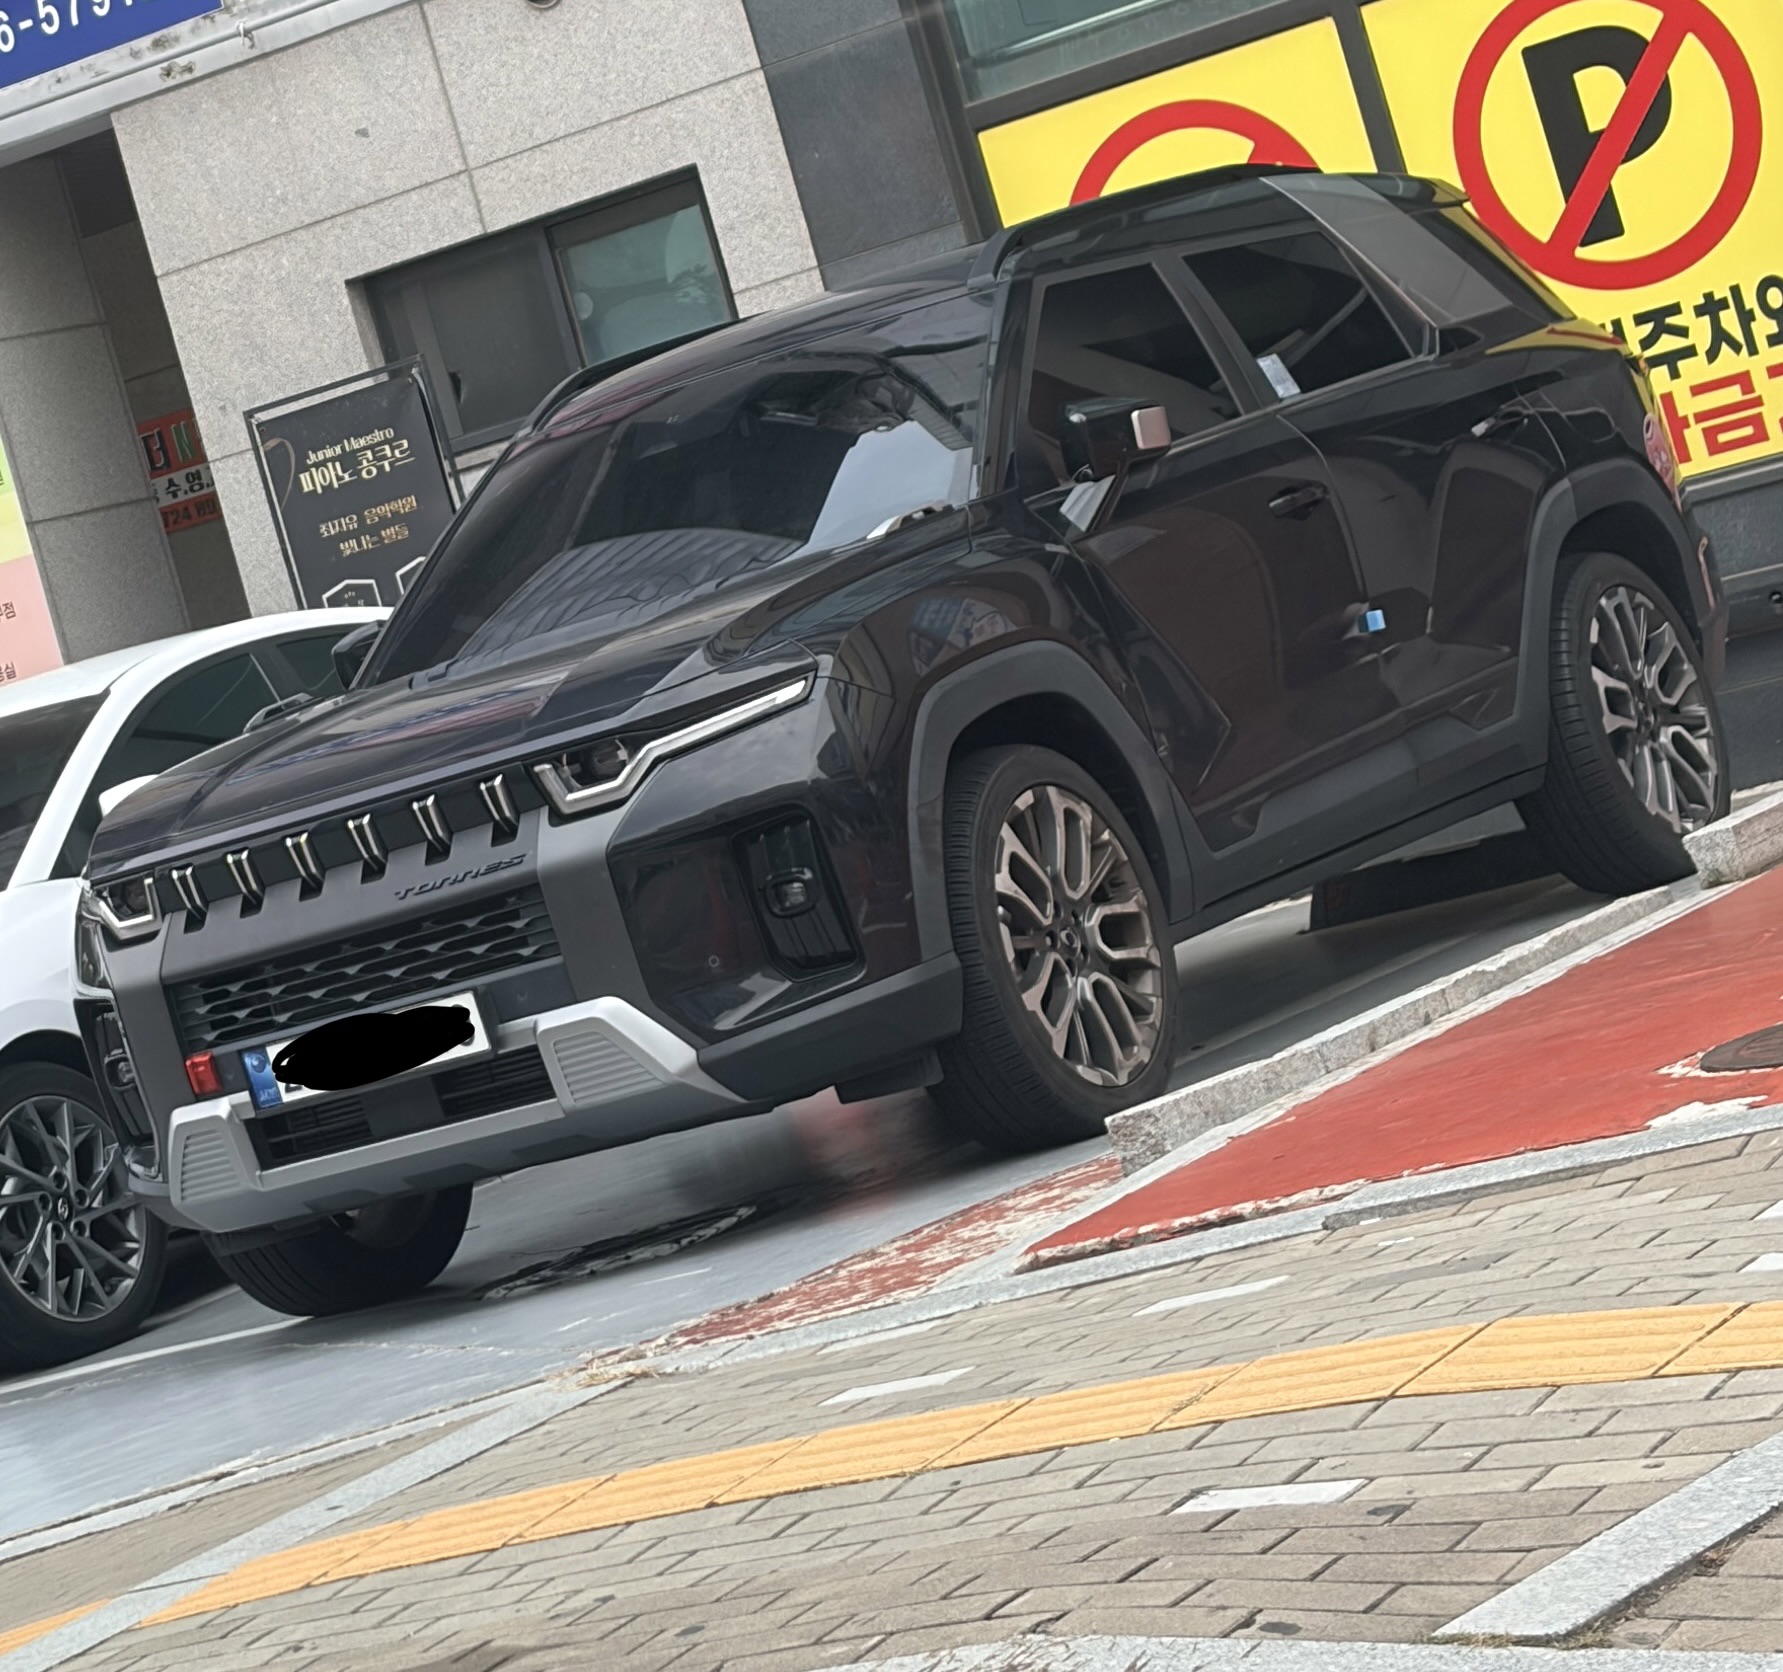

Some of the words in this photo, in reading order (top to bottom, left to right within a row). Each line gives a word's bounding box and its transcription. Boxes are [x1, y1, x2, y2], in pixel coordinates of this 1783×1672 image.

[306, 443, 343, 465] Junior
[343, 427, 395, 452] Maestro
[298, 461, 358, 494] 피아노
[356, 439, 416, 479] 콩쿠르
[363, 494, 418, 525] 음악학원
[339, 534, 381, 557] 빛나는
